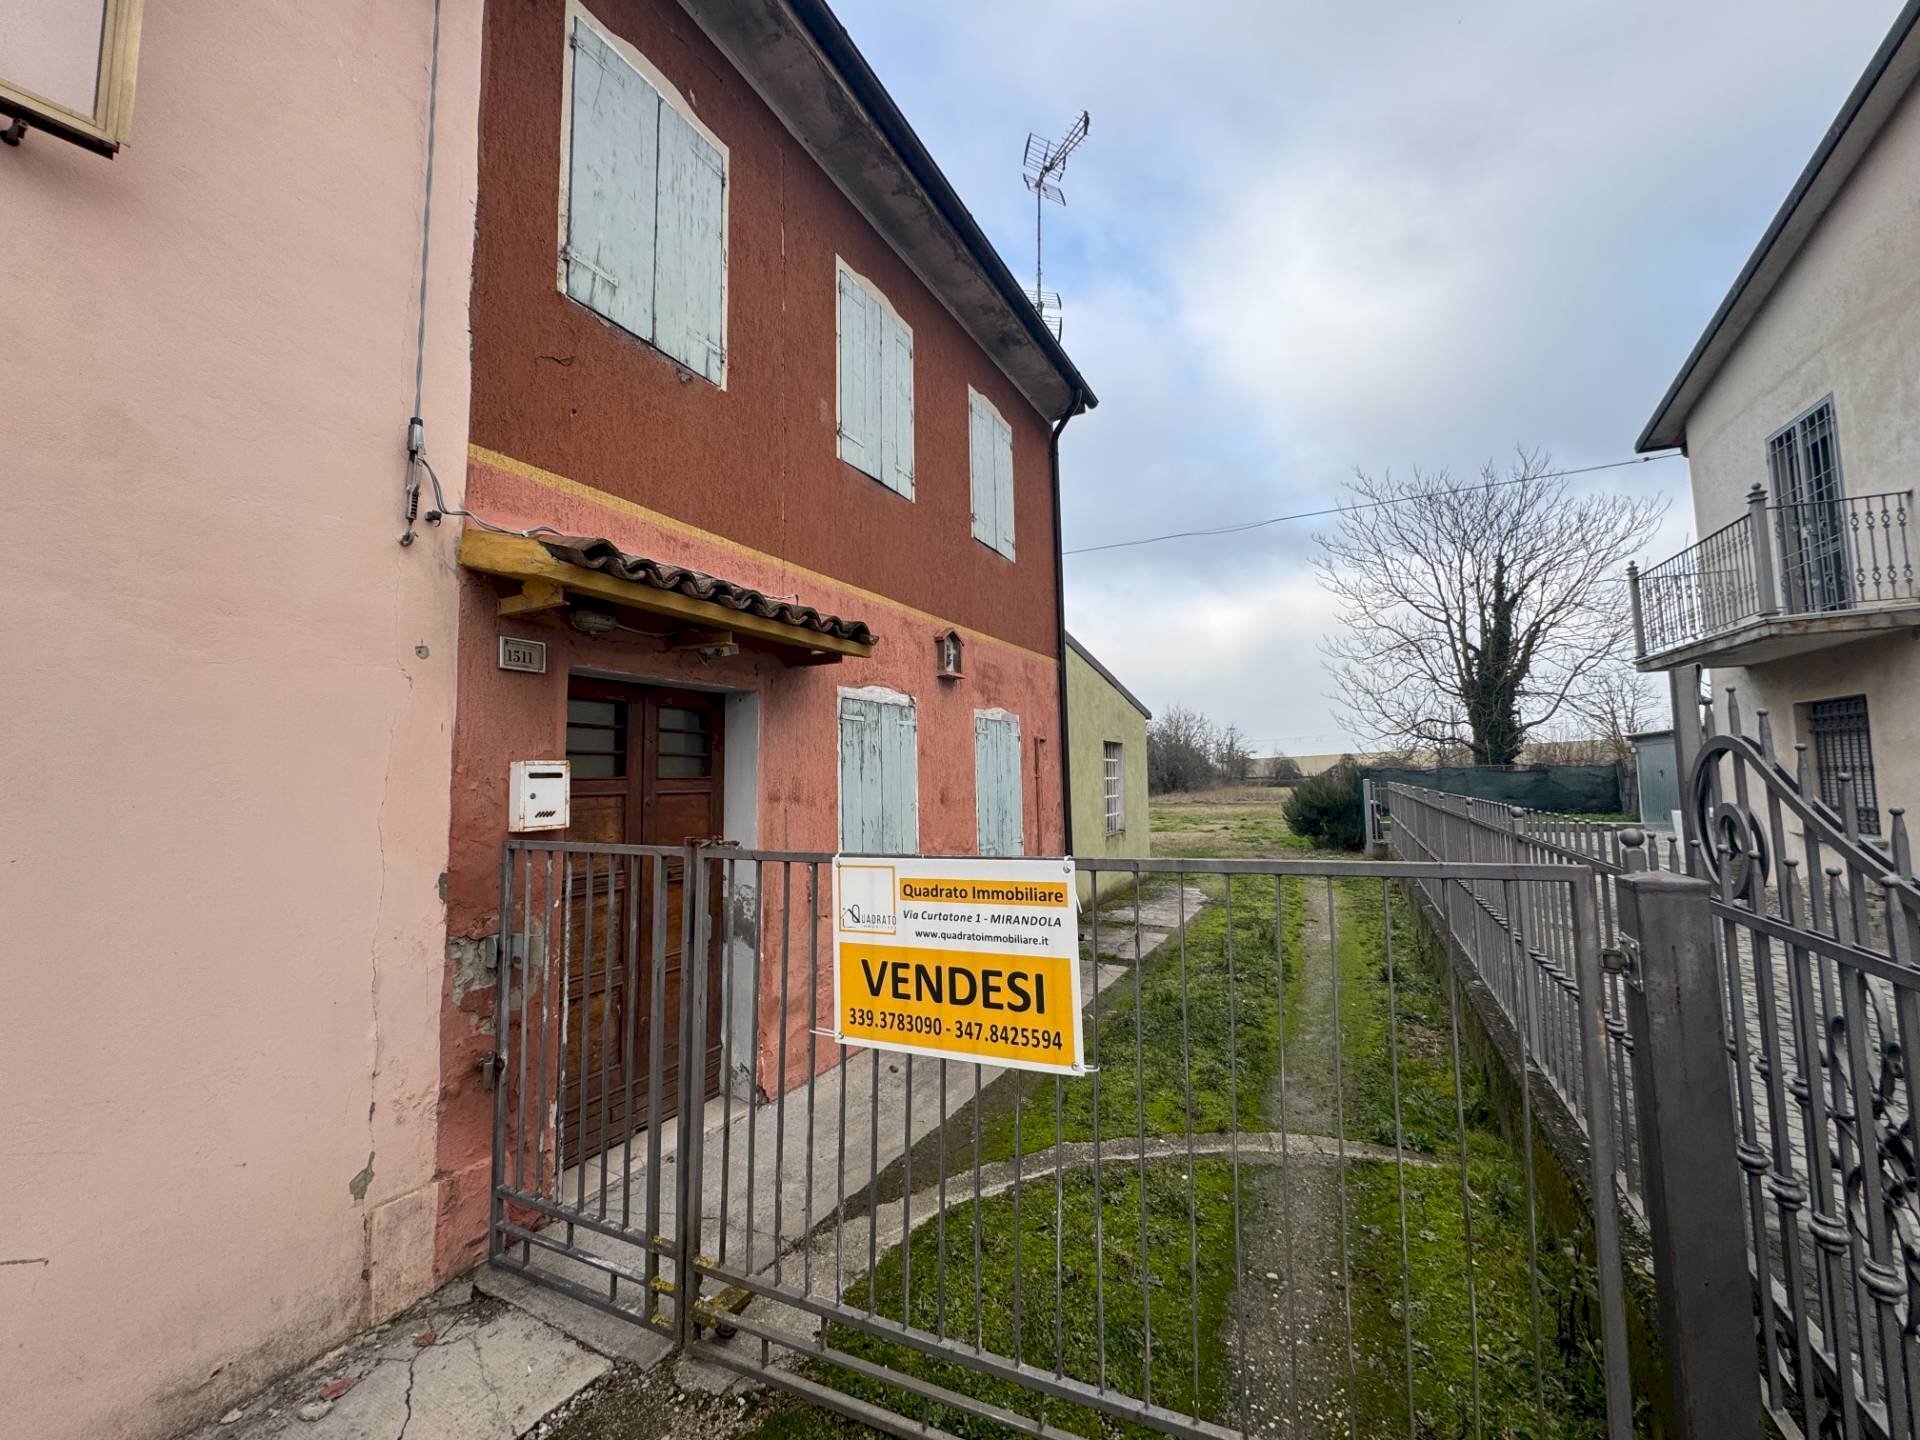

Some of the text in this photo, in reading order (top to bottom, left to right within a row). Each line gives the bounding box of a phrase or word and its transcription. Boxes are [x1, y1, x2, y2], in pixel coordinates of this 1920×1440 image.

[507, 649, 533, 664] 1511
[903, 884, 1064, 903] Quadrato Immobiliare
[851, 904, 896, 925] QUADRATO
[903, 910, 919, 921] Via
[921, 910, 973, 923] Curtatone
[974, 912, 981, 923] 1
[990, 914, 1062, 927] MIRANDOLA
[915, 929, 1049, 946] www.quadratoimmobiliare.it
[861, 959, 1045, 1014] VENDESI
[849, 1008, 942, 1035] 339.3783090
[955, 1020, 1063, 1050] 347.8425594
